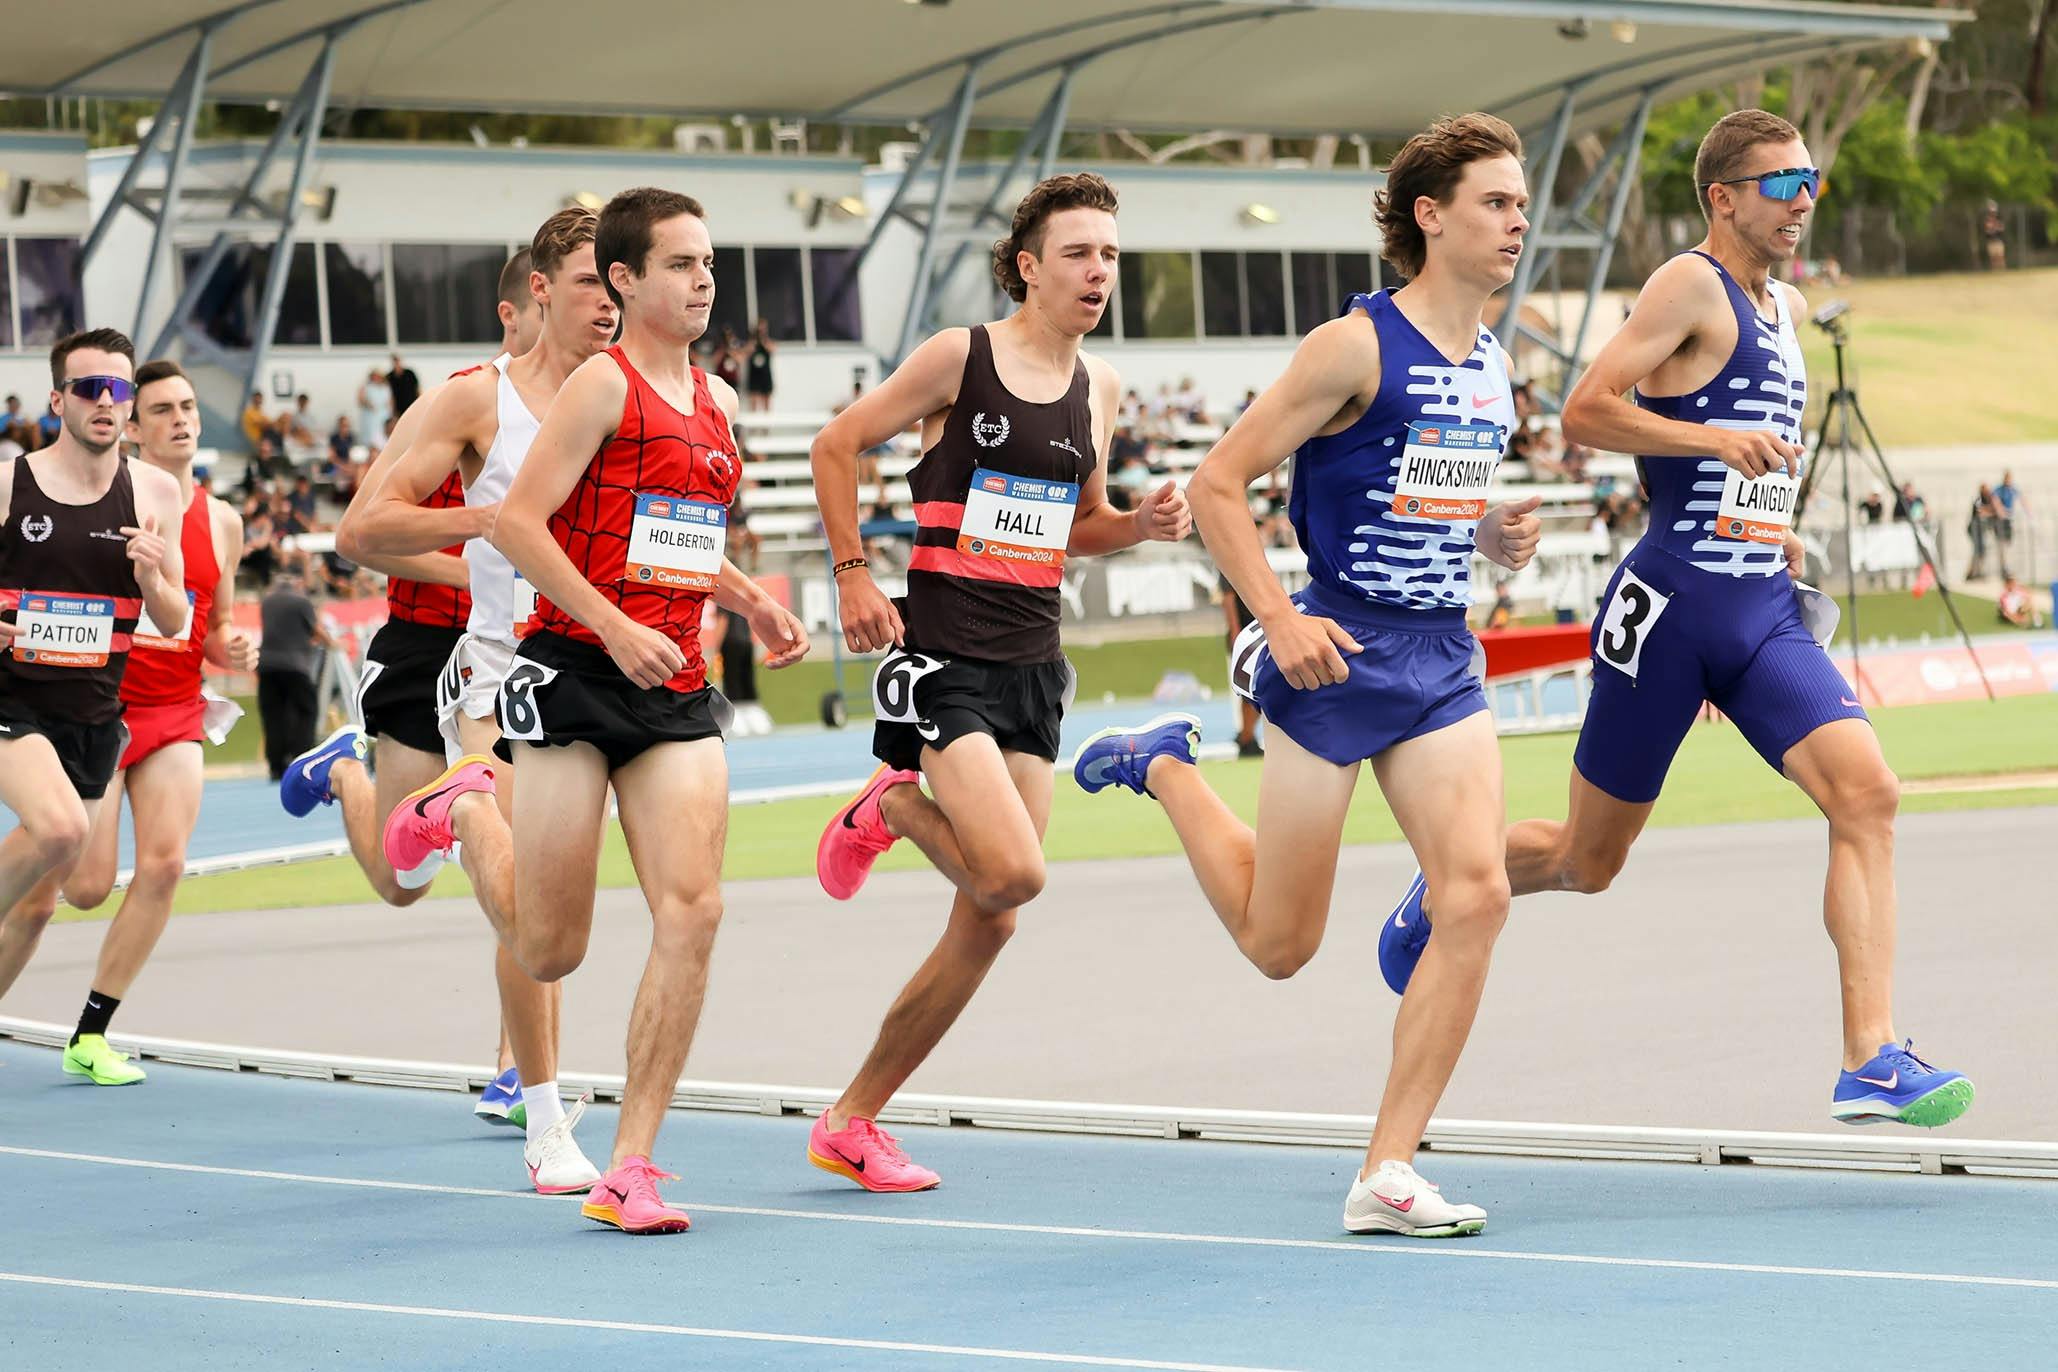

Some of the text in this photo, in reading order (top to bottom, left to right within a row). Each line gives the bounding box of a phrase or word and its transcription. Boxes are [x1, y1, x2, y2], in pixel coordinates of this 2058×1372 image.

[980, 423, 1002, 434] ETC
[1445, 429, 1476, 441] CHEMIST
[1406, 457, 1491, 488] HINCKSMAN
[1013, 481, 1047, 494] CHEMIST
[676, 503, 706, 517] CHEMIST
[1423, 502, 1478, 516] Canberra2024
[995, 509, 1045, 536] HALL
[649, 528, 716, 552] HOLBERTON
[989, 545, 1054, 563] Canberra2024
[657, 571, 712, 588] Canberra2024
[1603, 582, 1651, 665] 3
[30, 622, 98, 644] PATTON
[40, 652, 99, 665] Canberra2024
[877, 654, 928, 718] 6
[504, 664, 546, 735] 8
